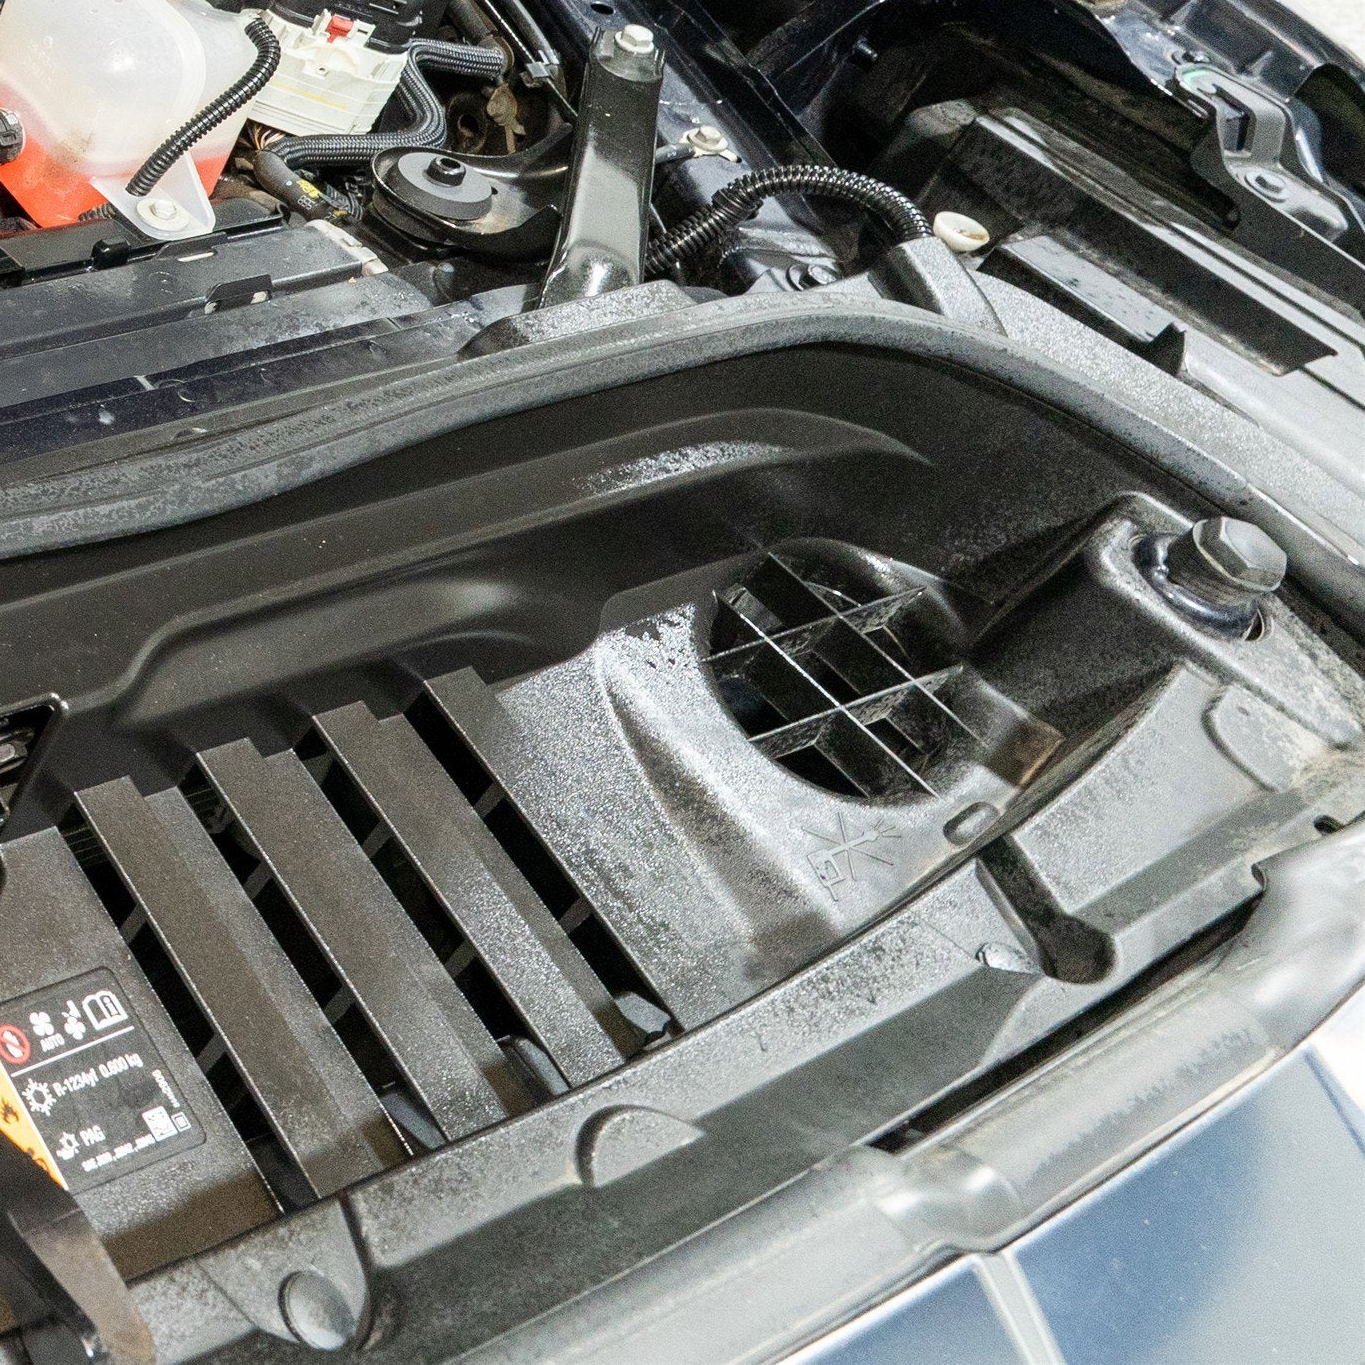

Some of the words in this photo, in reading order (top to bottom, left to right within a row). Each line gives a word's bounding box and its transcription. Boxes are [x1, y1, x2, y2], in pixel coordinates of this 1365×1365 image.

[39, 1032, 65, 1052] AUTO
[52, 1068, 99, 1098] R-1234yf
[124, 1052, 144, 1068] kg
[79, 1125, 105, 1147] PAG
